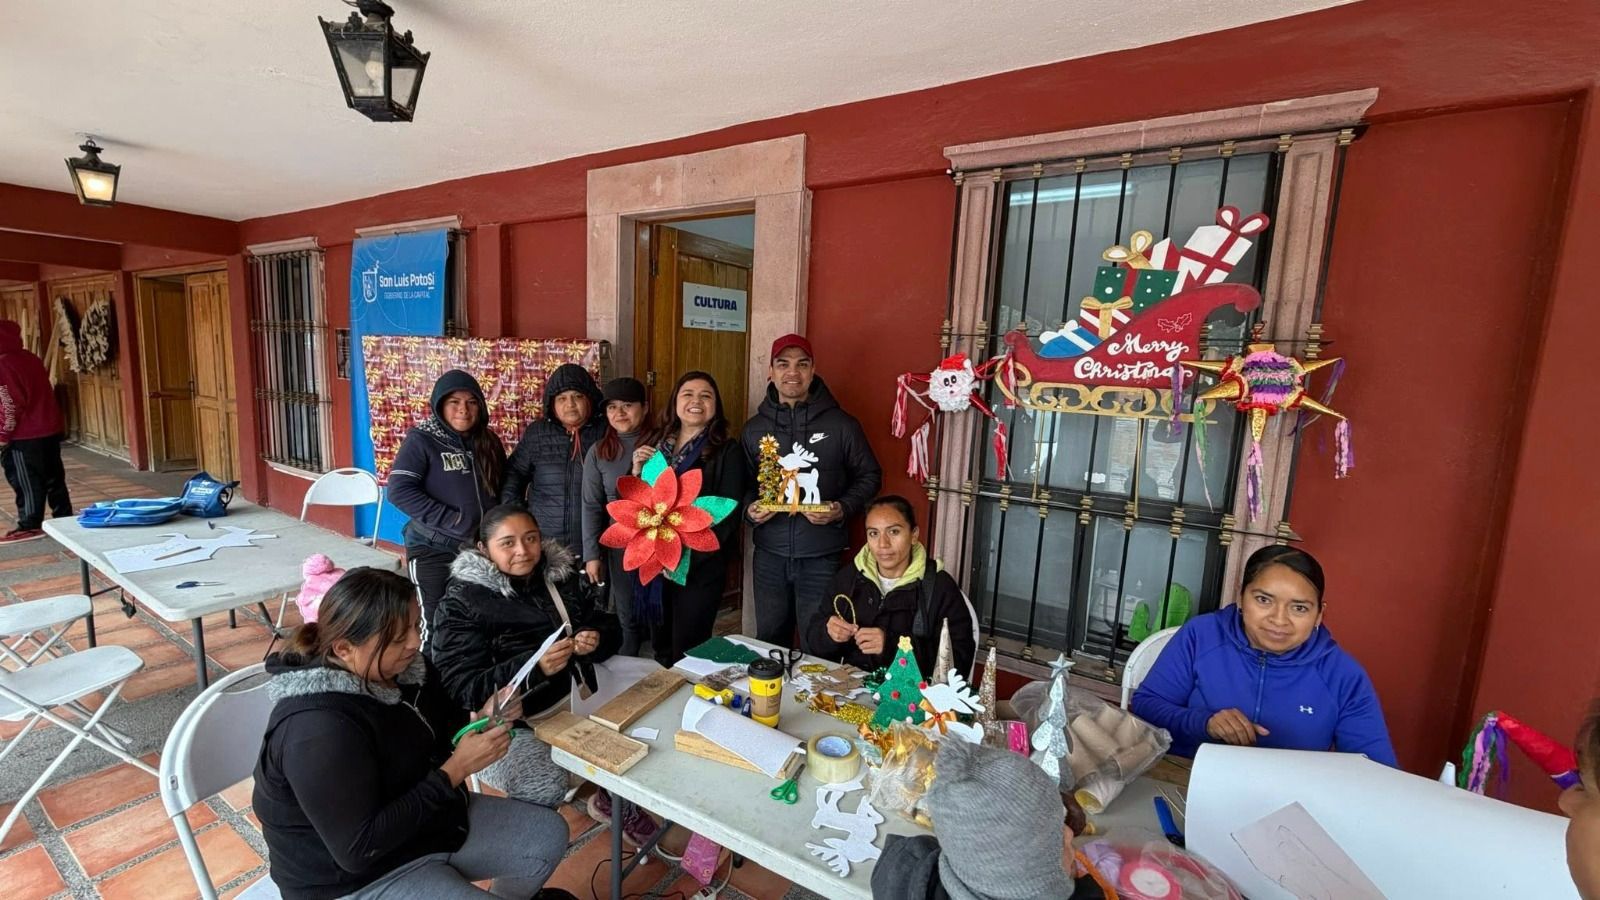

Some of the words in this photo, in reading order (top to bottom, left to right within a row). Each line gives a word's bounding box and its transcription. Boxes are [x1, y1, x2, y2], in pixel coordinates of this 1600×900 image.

[379, 275, 393, 288] San
[393, 273, 409, 287] Luis
[694, 295, 738, 311] CULTURA
[1107, 333, 1190, 362] Merry
